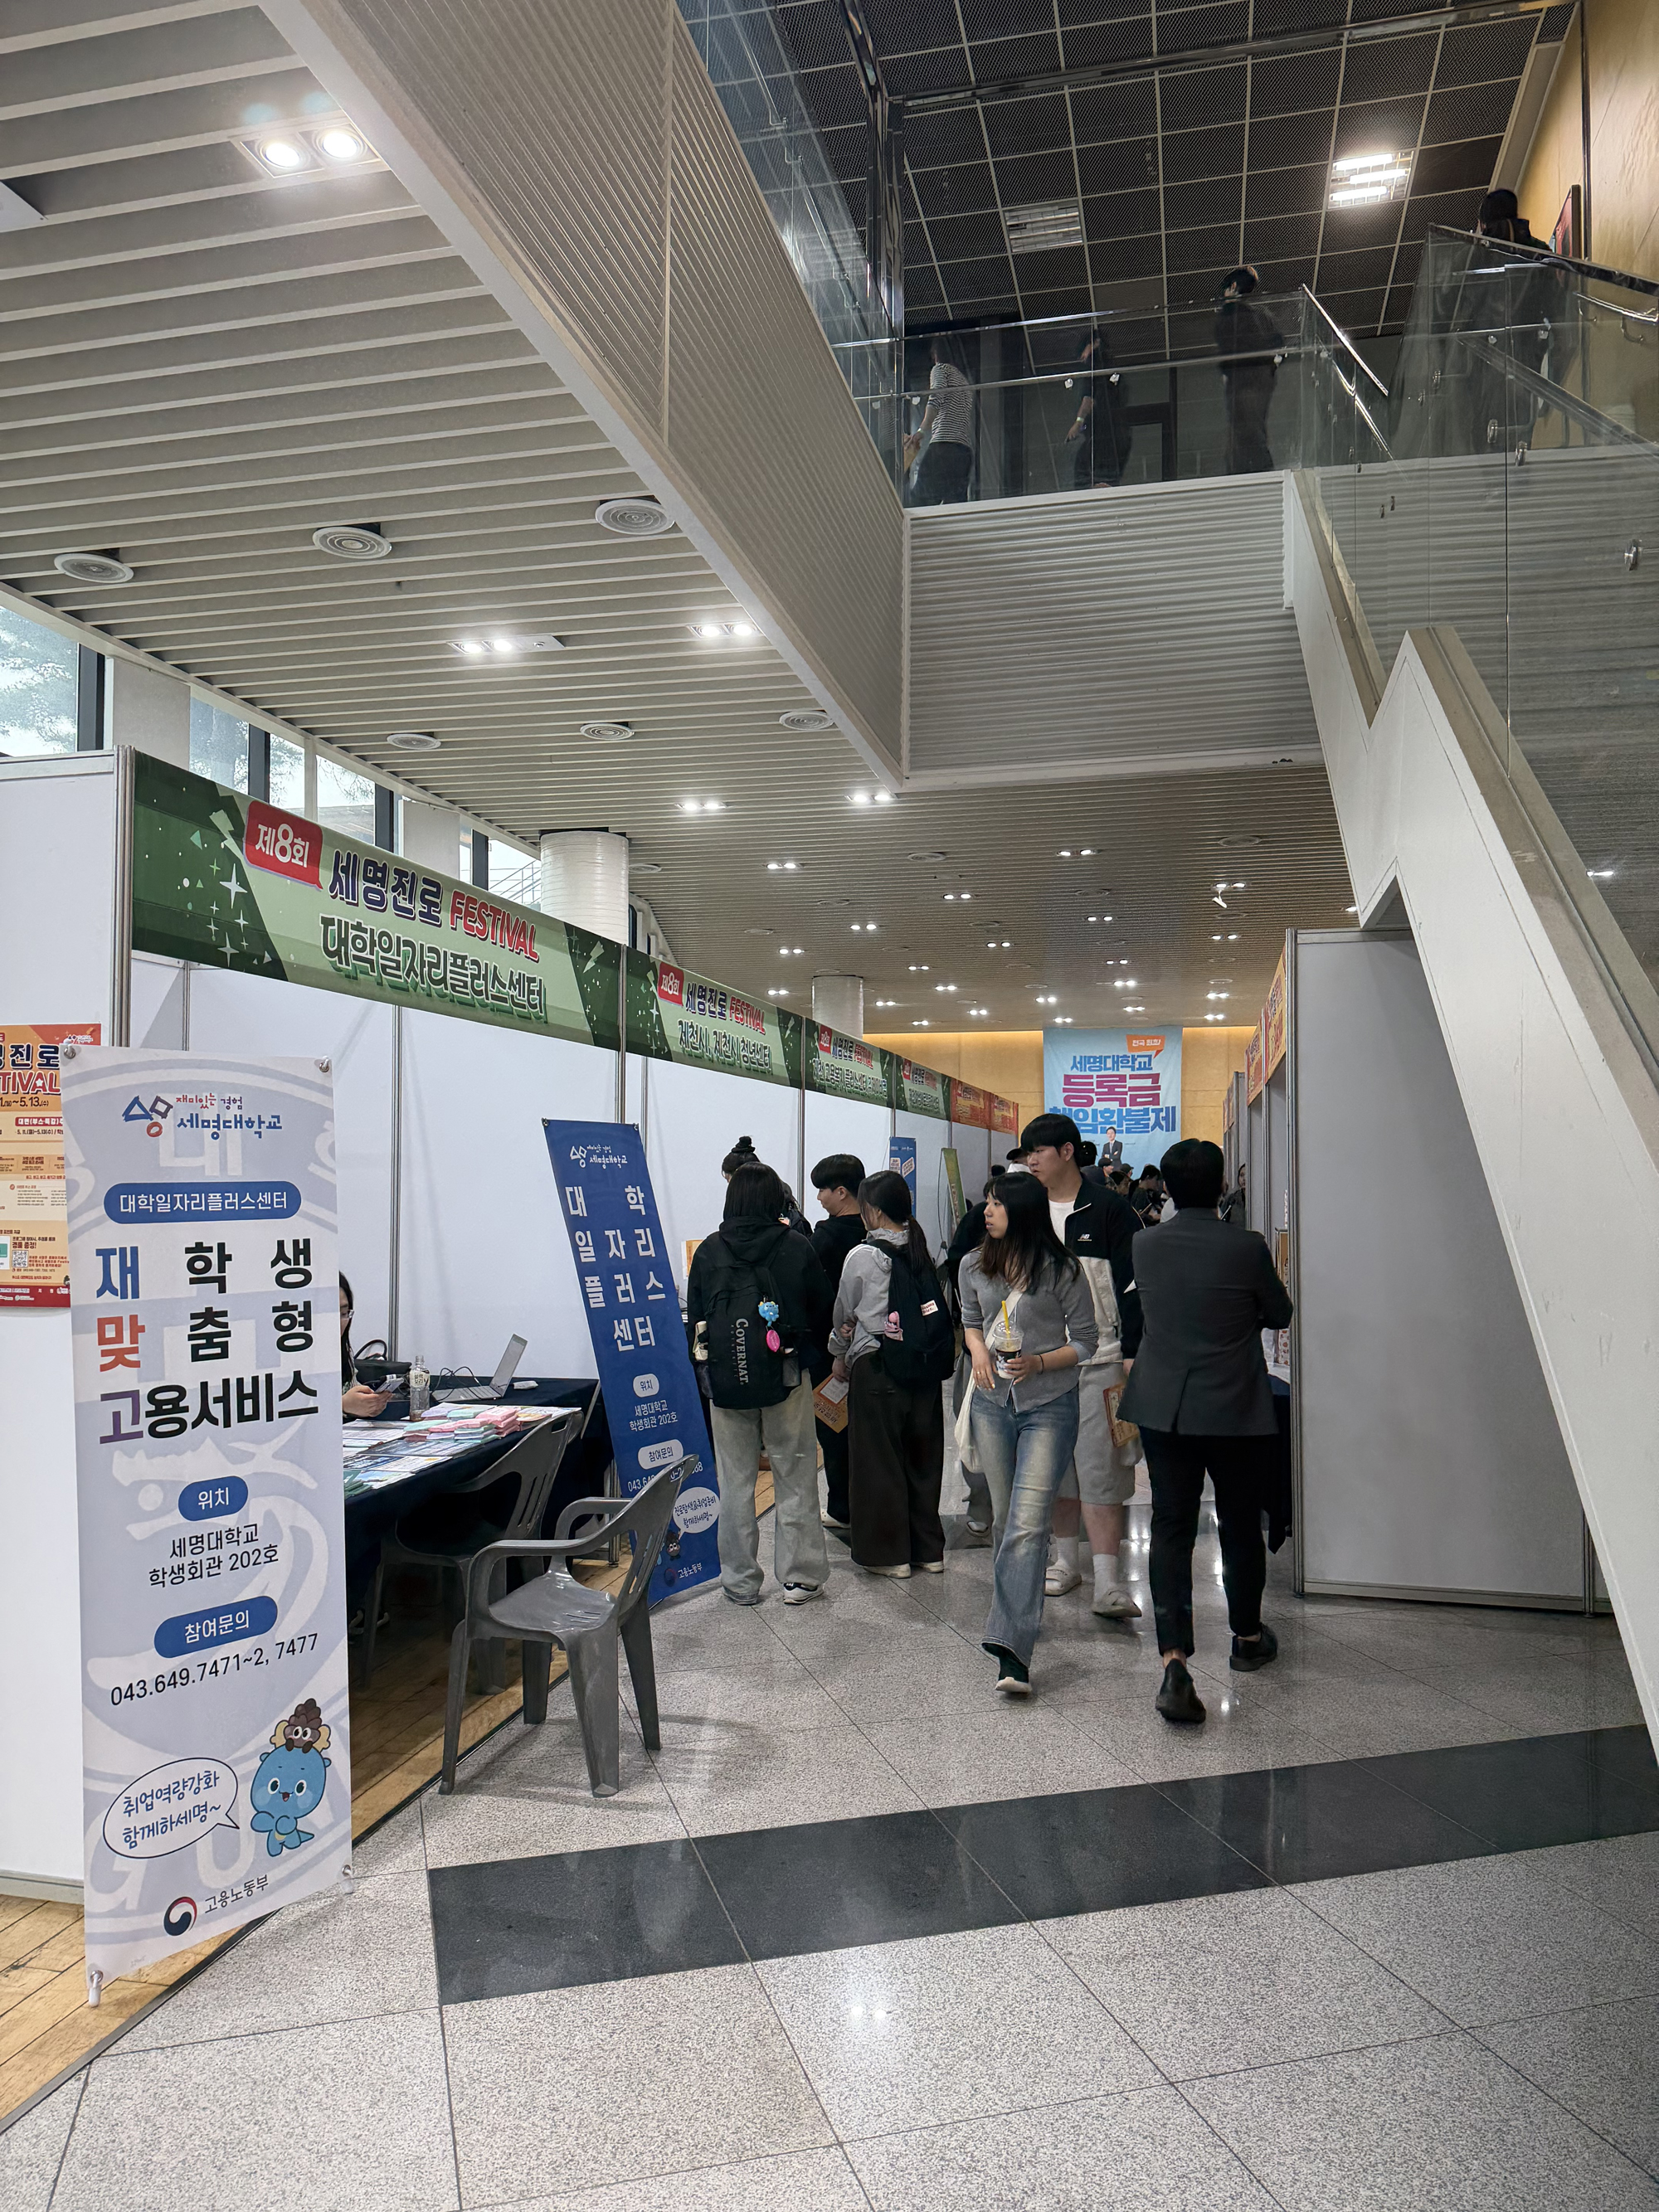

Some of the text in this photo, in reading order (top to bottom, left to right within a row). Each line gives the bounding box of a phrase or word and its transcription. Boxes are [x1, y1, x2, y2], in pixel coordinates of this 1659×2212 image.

[255, 823, 309, 868] 제8회
[328, 848, 541, 964] 세명진로 FESTIVAL
[319, 913, 548, 1022] 대학일자리플러스센터
[661, 972, 679, 995] 제8회
[686, 982, 766, 1035] 세명진로 FESTIVAL
[0, 1043, 60, 1069] 진로
[1070, 1054, 1153, 1072] 세명대학교
[176, 1092, 242, 1110] 재미있는 경험
[1062, 1072, 1161, 1107] 등록금
[177, 1113, 283, 1140] 세명대학교
[590, 1154, 628, 1169] 세명대학교
[119, 1191, 287, 1213] 대학일자리플러스센터
[614, 1315, 655, 1352] 센터
[736, 1318, 748, 1383] COVERNAT
[640, 1379, 653, 1391] 위치
[99, 1369, 319, 1445] 고용서비스
[629, 1411, 678, 1432] 학생회관 202호
[635, 1399, 668, 1417] 세명대학교
[649, 1446, 674, 1462] 참여문의
[197, 1486, 229, 1510] 위치
[170, 1523, 259, 1559] 세명대학교
[148, 1544, 279, 1588] 학생회관 202호
[678, 1562, 703, 1578] 고용노동부
[184, 1610, 250, 1644] 참여문의
[111, 1632, 319, 1706] 043.649.7471~2, 7477
[123, 1770, 220, 1817] 취업역량강화
[123, 1801, 221, 1850] 함께하세명~
[205, 1874, 269, 1913] 고용노동부
